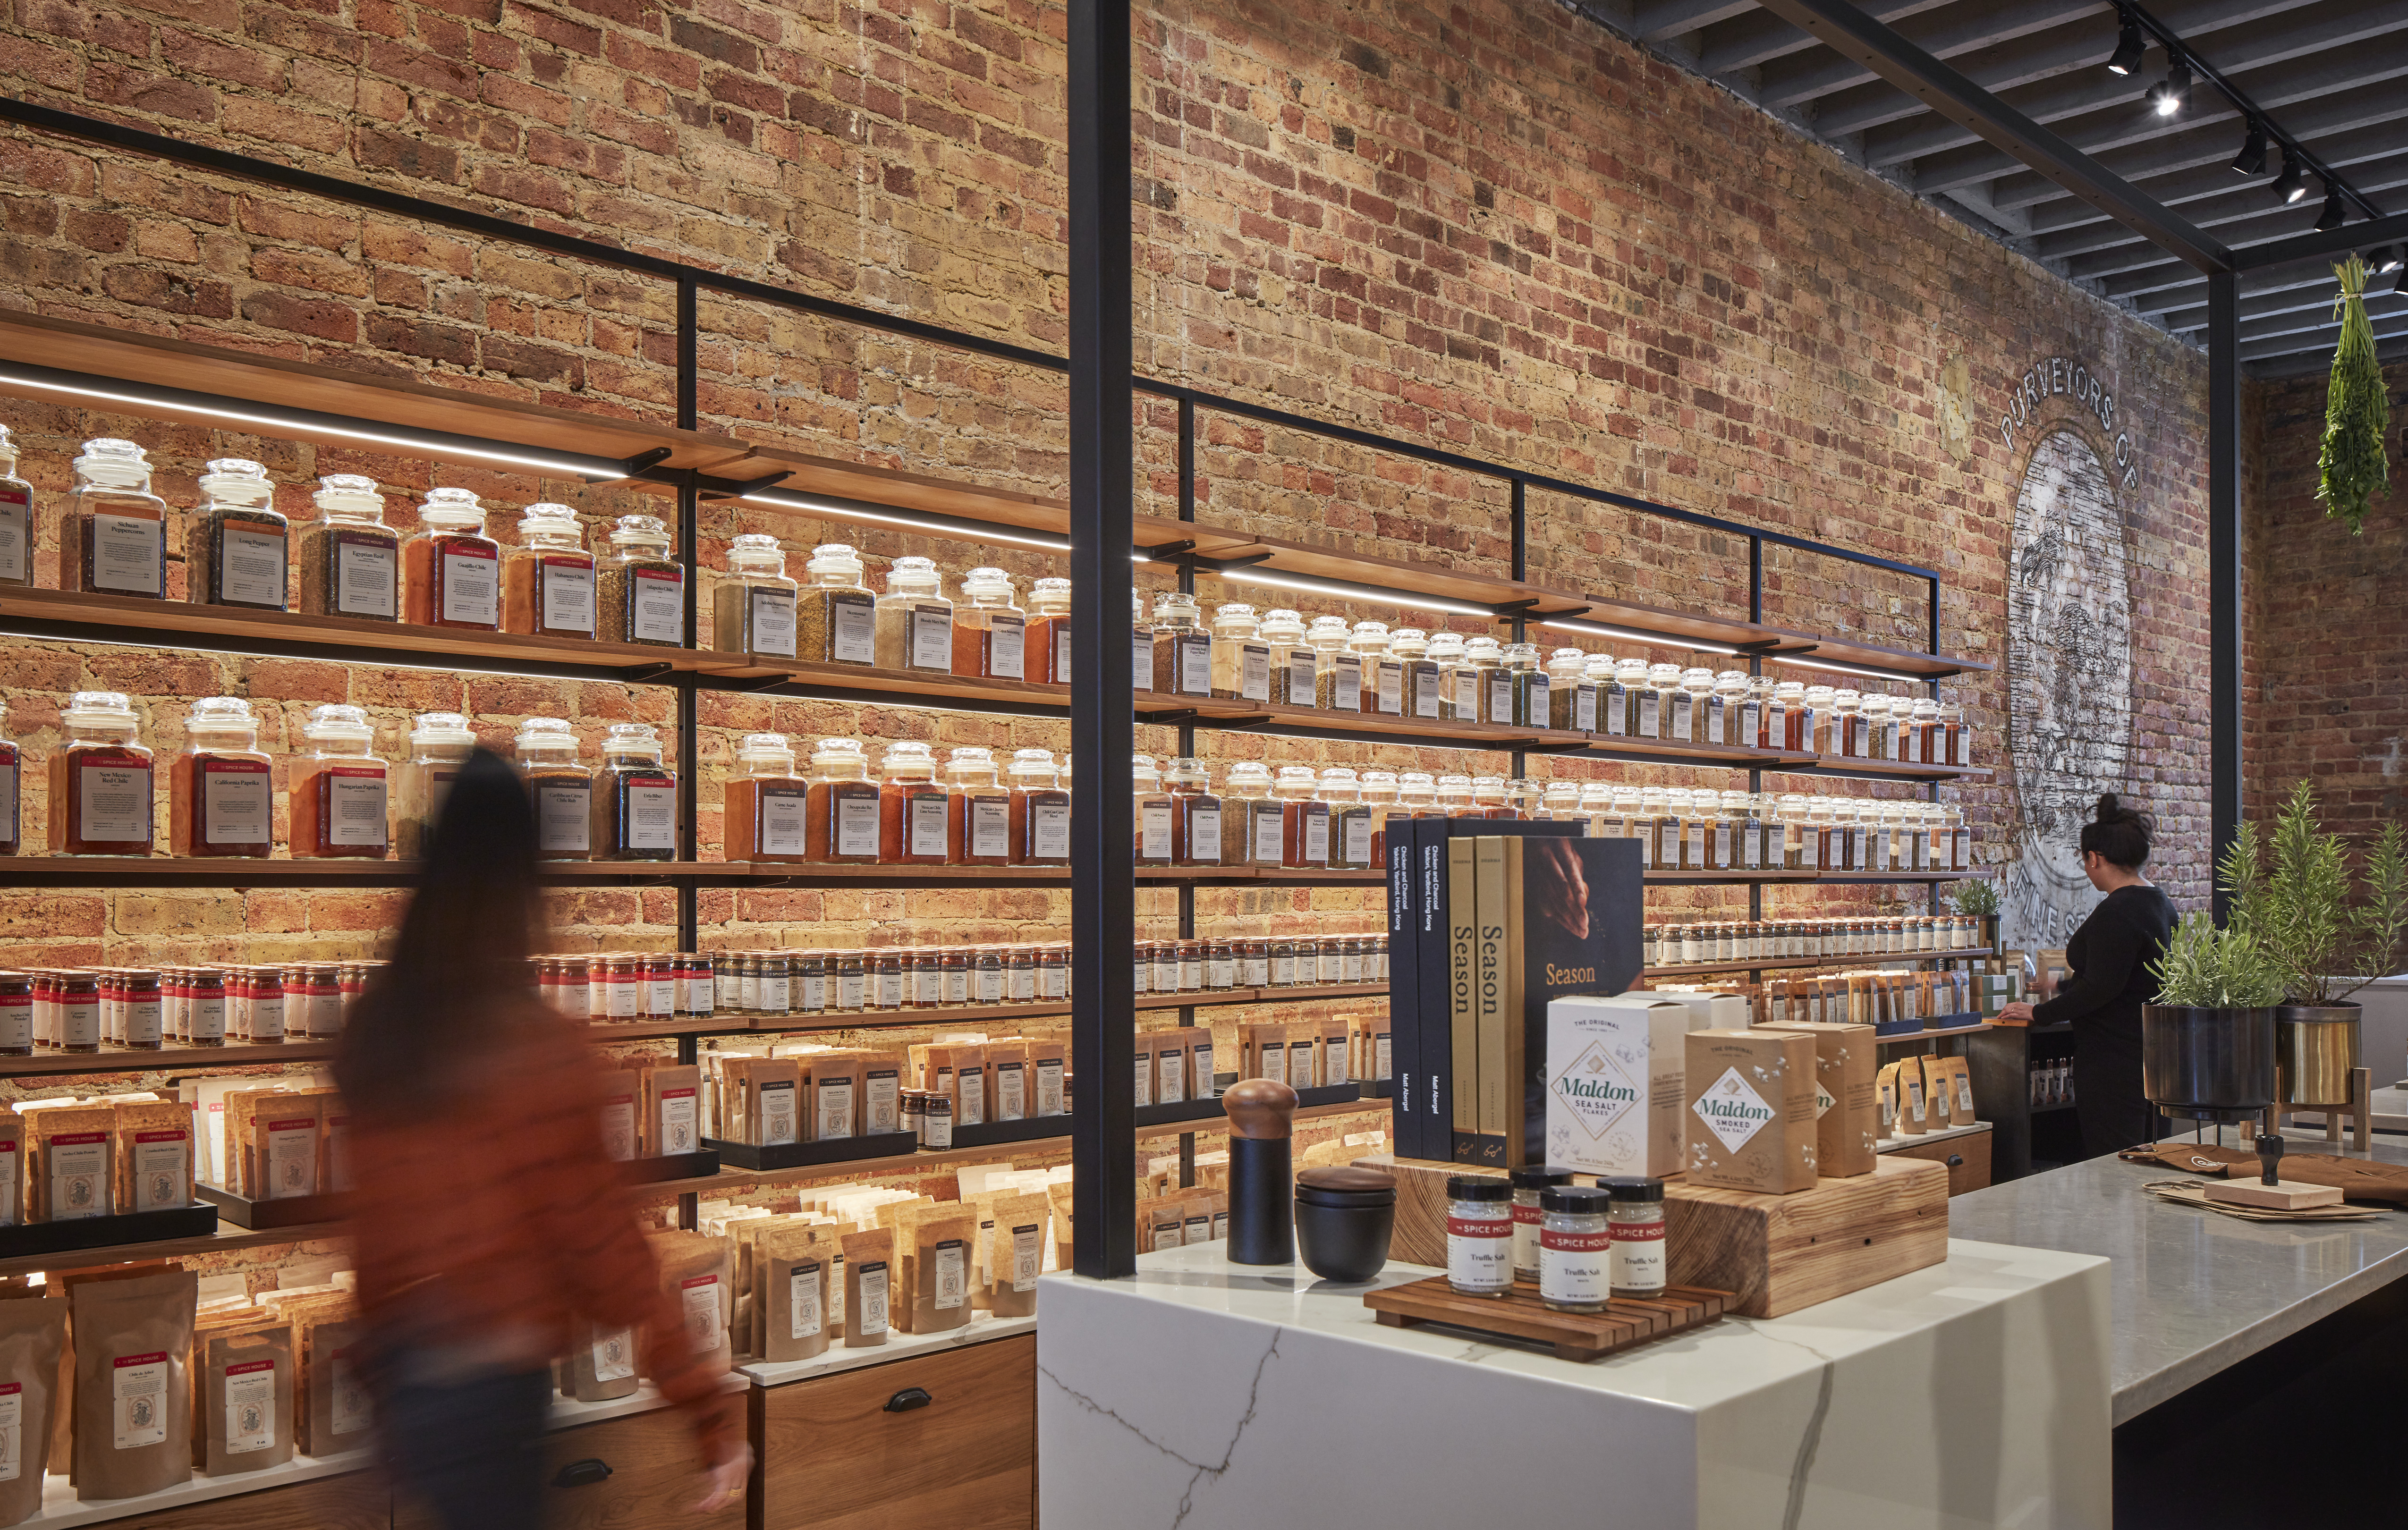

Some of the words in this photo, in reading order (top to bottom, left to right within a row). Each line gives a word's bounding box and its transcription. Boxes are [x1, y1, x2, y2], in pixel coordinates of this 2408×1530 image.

[2001, 357, 2113, 454] PURVEYORS
[111, 526, 145, 534] Peppercorns
[2014, 864, 2058, 946] FINE
[1454, 926, 1473, 1014] Season
[1482, 926, 1502, 1015] Season
[1546, 963, 1595, 986] Season
[1589, 1019, 1619, 1030] ORIGINAL
[1724, 1046, 1753, 1055] ORIGINAL
[1560, 1077, 1635, 1101] Maldon
[1575, 1100, 1593, 1108] SEA
[1595, 1102, 1616, 1110] SALT
[1698, 1099, 1769, 1120] Maldon
[1716, 1119, 1750, 1128] SMOKED
[1464, 1225, 1490, 1234] SPICE
[1616, 1228, 1644, 1237] SPICE
[1557, 1238, 1584, 1247] SPICE
[1470, 1253, 1493, 1261] Truffle
[1564, 1268, 1587, 1276] Truffle
